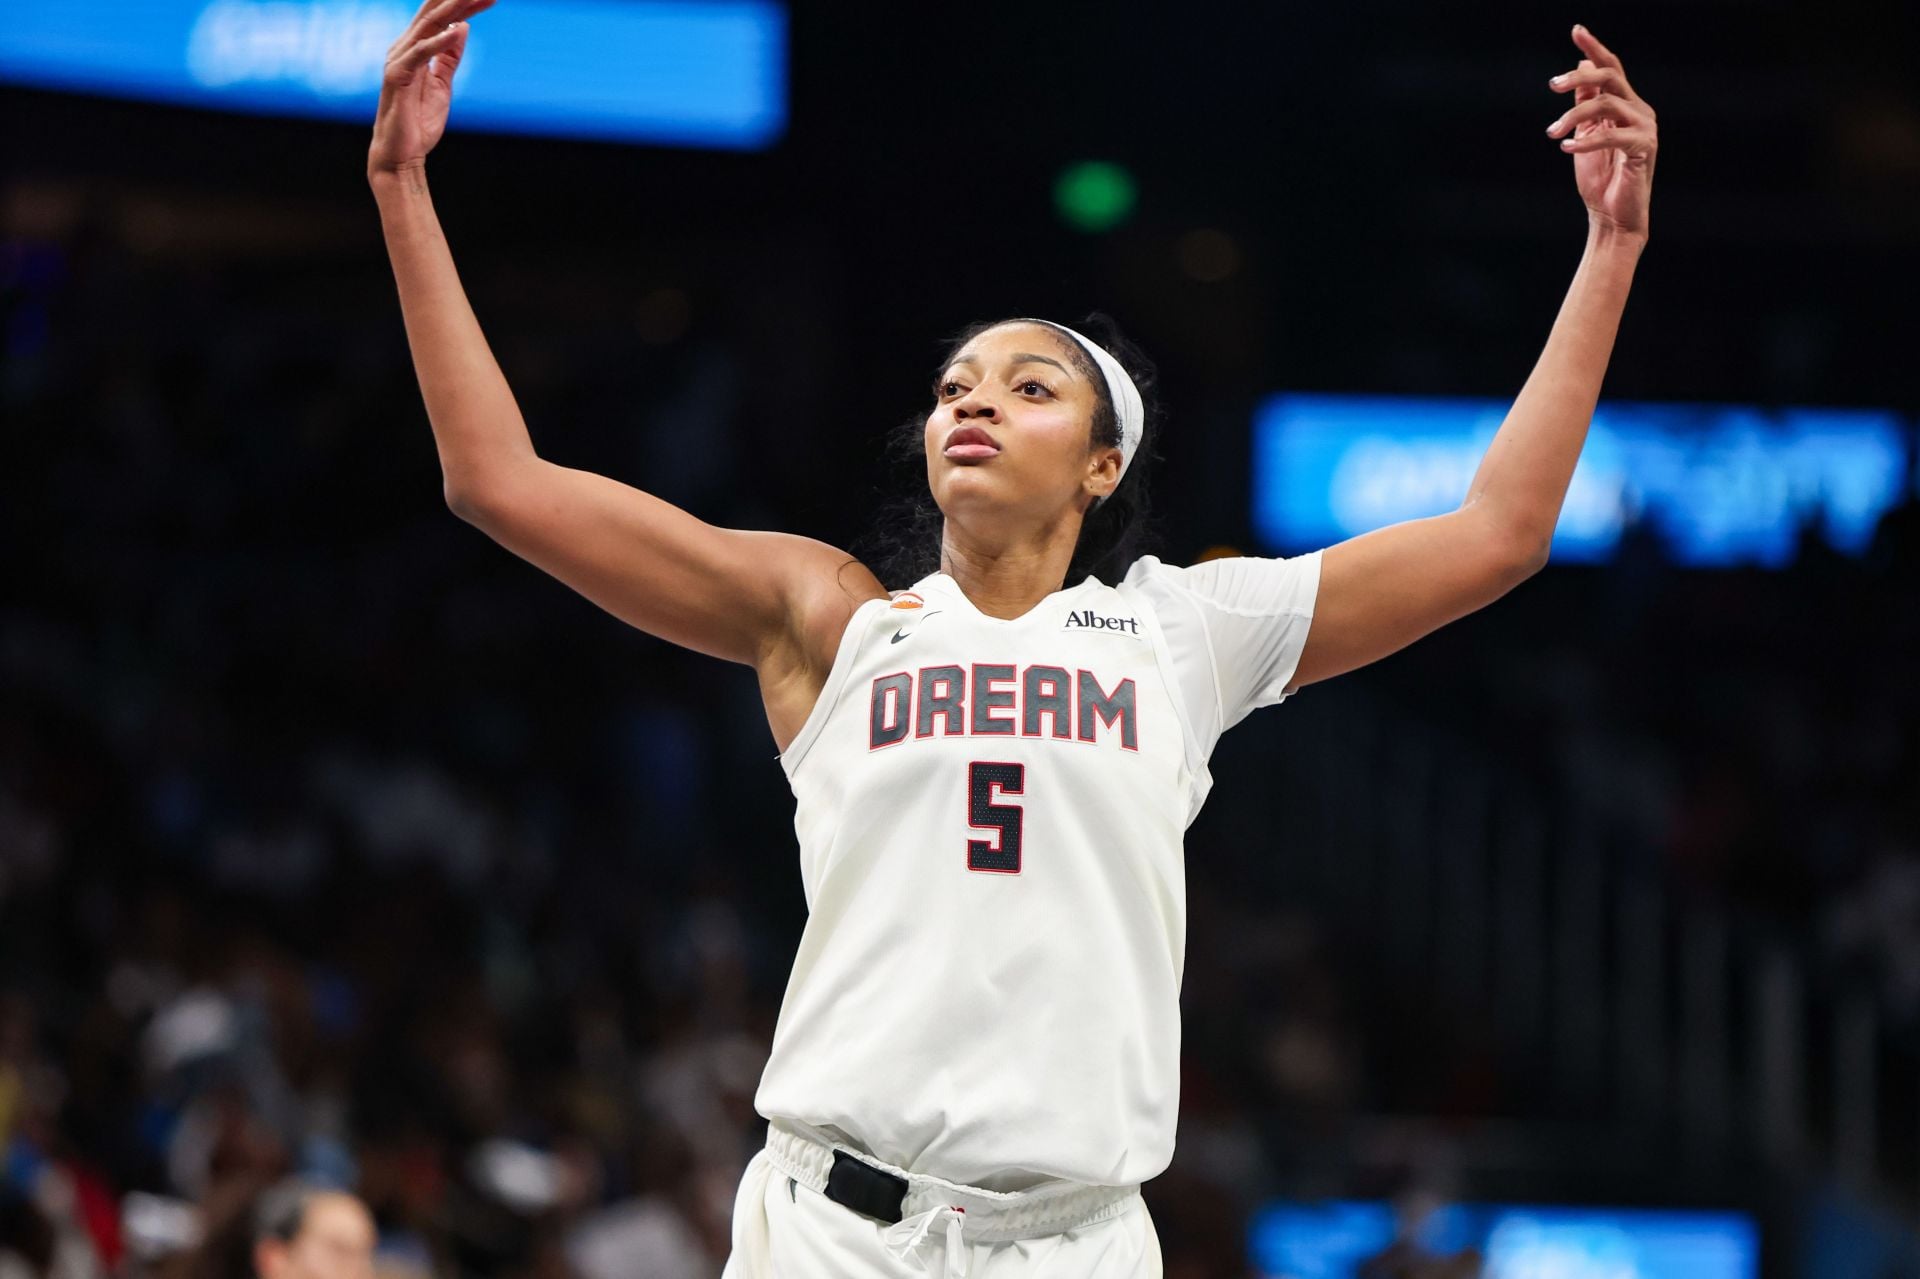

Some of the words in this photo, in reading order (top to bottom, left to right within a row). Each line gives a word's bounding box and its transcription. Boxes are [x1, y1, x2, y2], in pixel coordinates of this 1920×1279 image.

[1064, 610, 1139, 635] Albert
[869, 663, 1139, 751] DREAM
[967, 761, 1024, 873] 5
